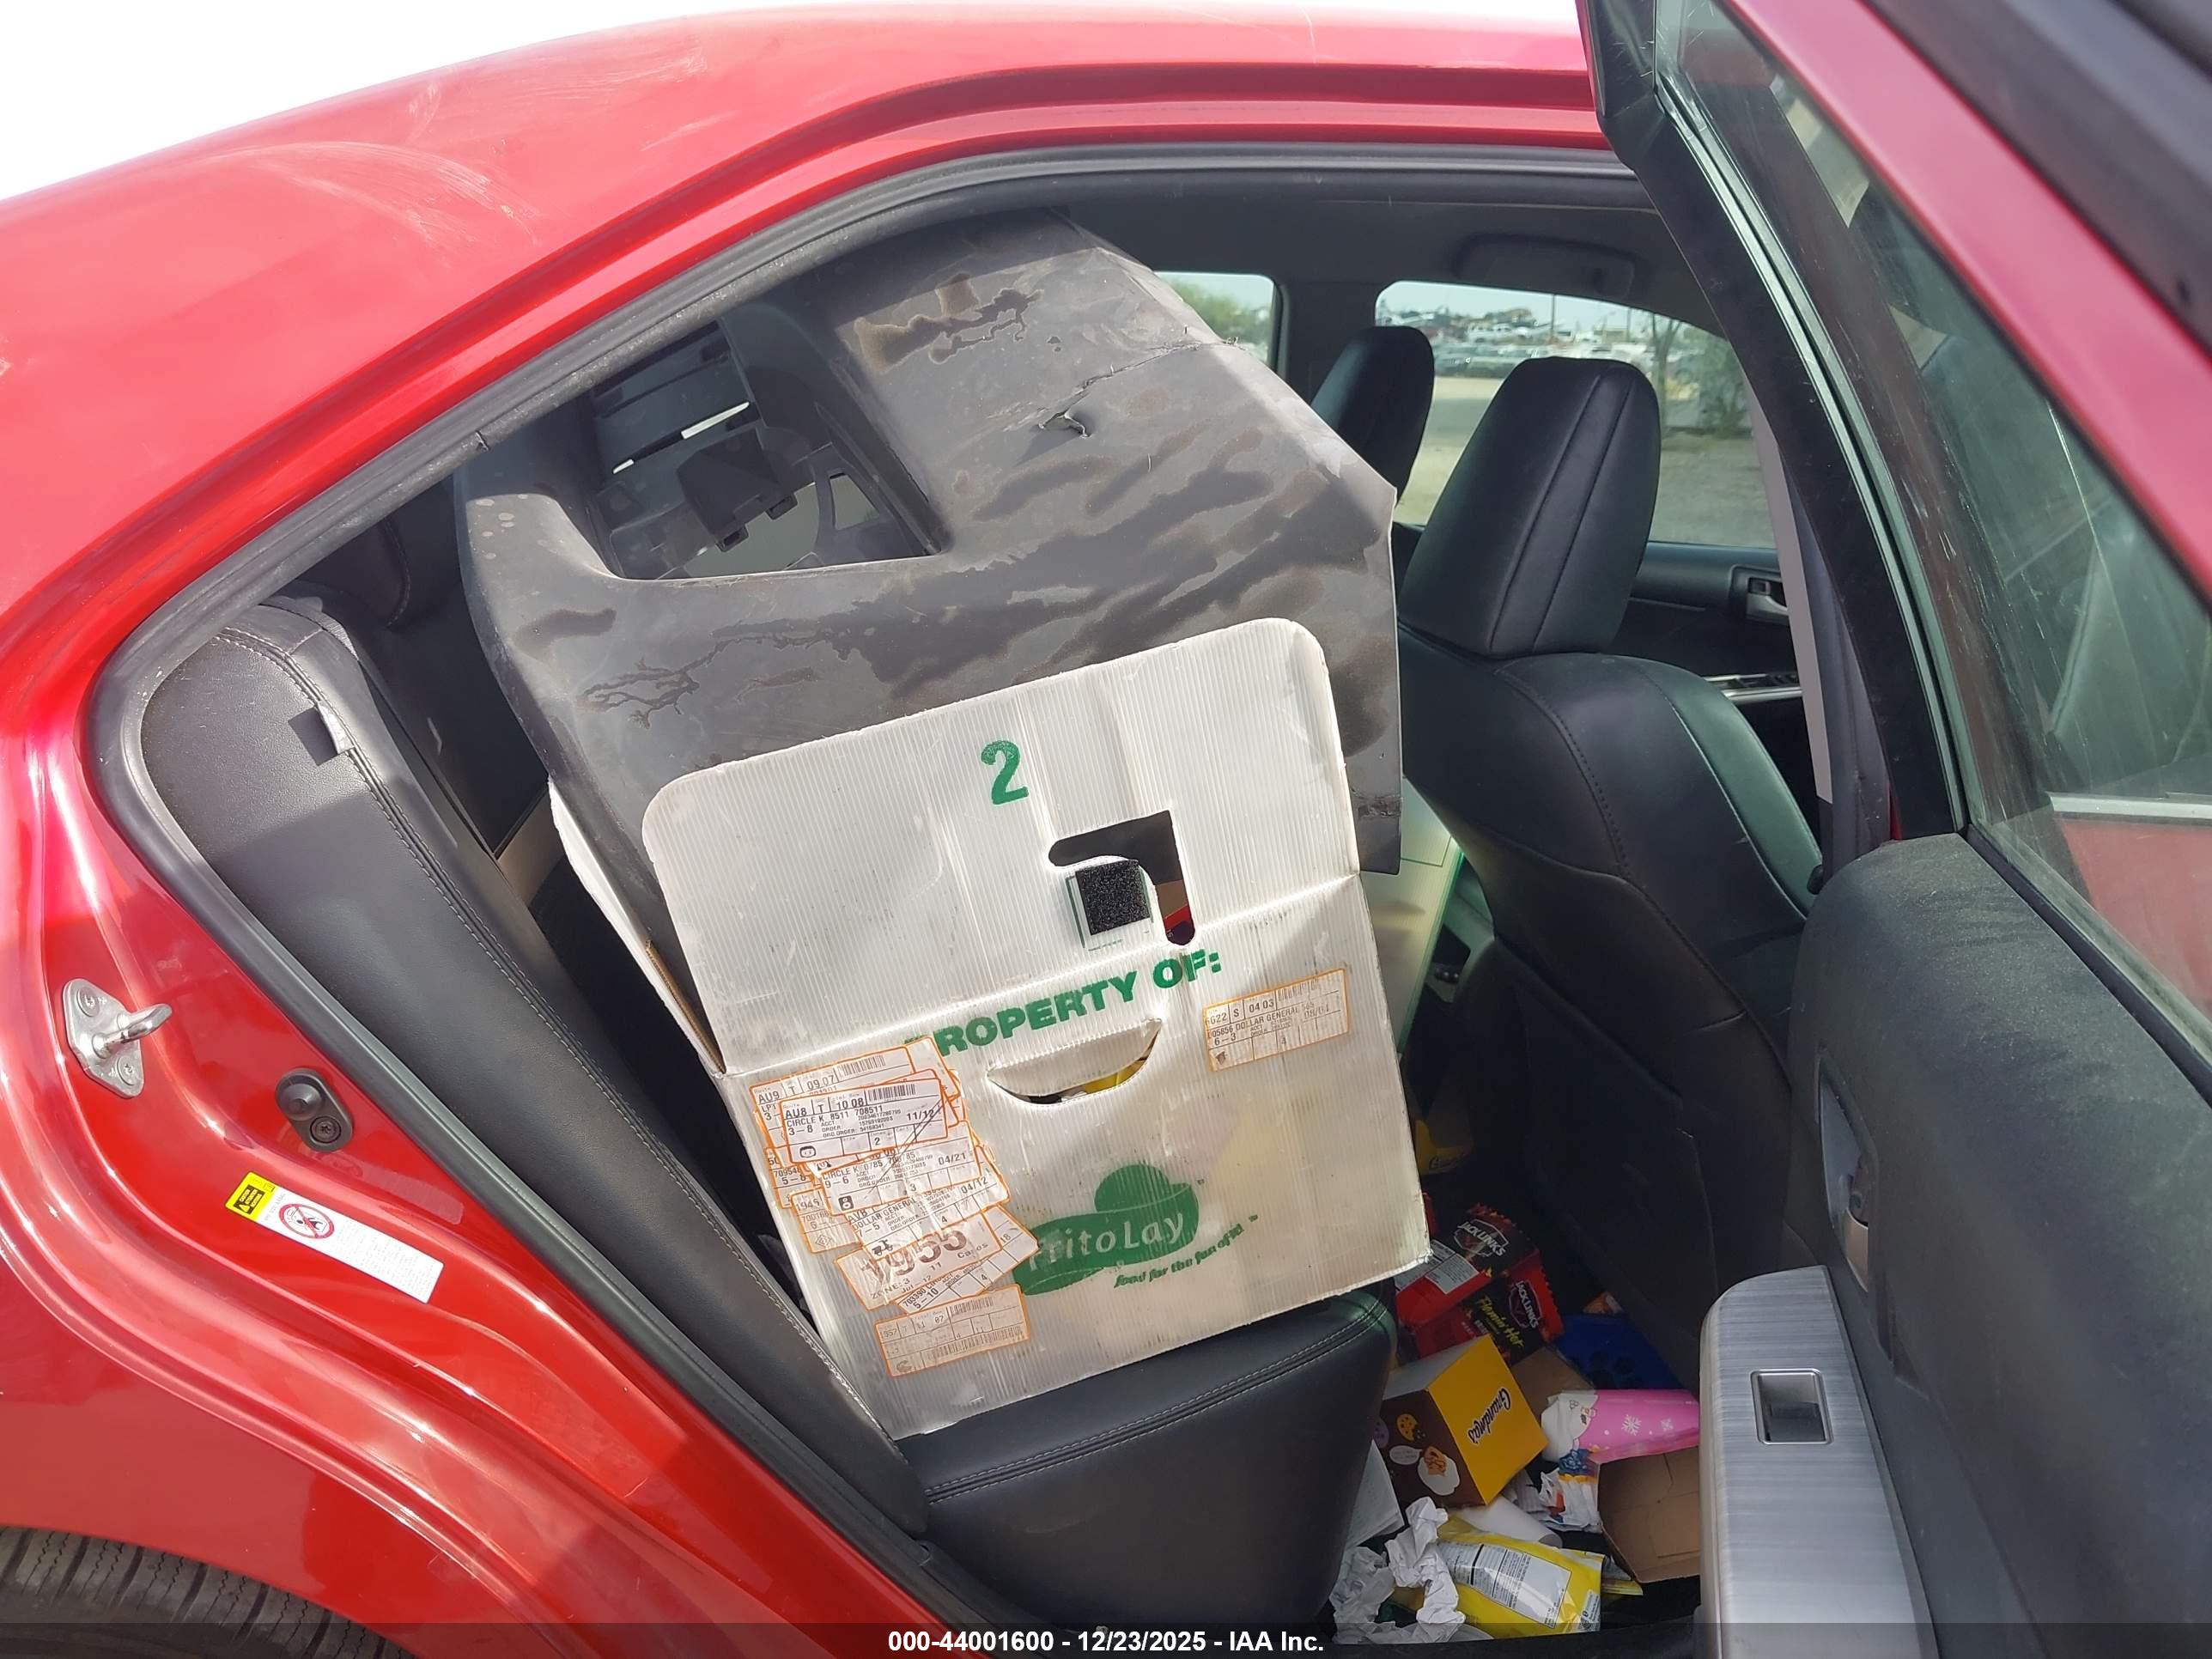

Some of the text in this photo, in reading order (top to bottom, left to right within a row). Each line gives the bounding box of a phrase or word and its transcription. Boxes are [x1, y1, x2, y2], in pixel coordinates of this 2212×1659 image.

[981, 740, 1029, 805] 2
[904, 949, 1222, 1056] ROPERTY OF:
[1236, 1016, 1265, 1031] DOLLAR
[758, 1091, 780, 1104] AU9
[807, 1080, 820, 1090] 09
[786, 1097, 864, 1119] AU8 T 10 08
[787, 1105, 883, 1128] CIRCLE K 8511 708511
[906, 1109, 934, 1121] 11/12
[939, 1152, 966, 1165] 04/21
[823, 1168, 851, 1181] CIRCLE
[961, 1176, 988, 1194] 04/12
[853, 1214, 884, 1231] DOLLAR
[941, 1215, 947, 1224] 4
[1457, 1221, 1481, 1238] JACK
[1114, 1268, 1146, 1289] food
[1149, 1266, 1169, 1283] for
[1170, 1256, 1193, 1273] the
[1194, 1244, 1217, 1265] fun
[902, 1287, 927, 1307] 703390
